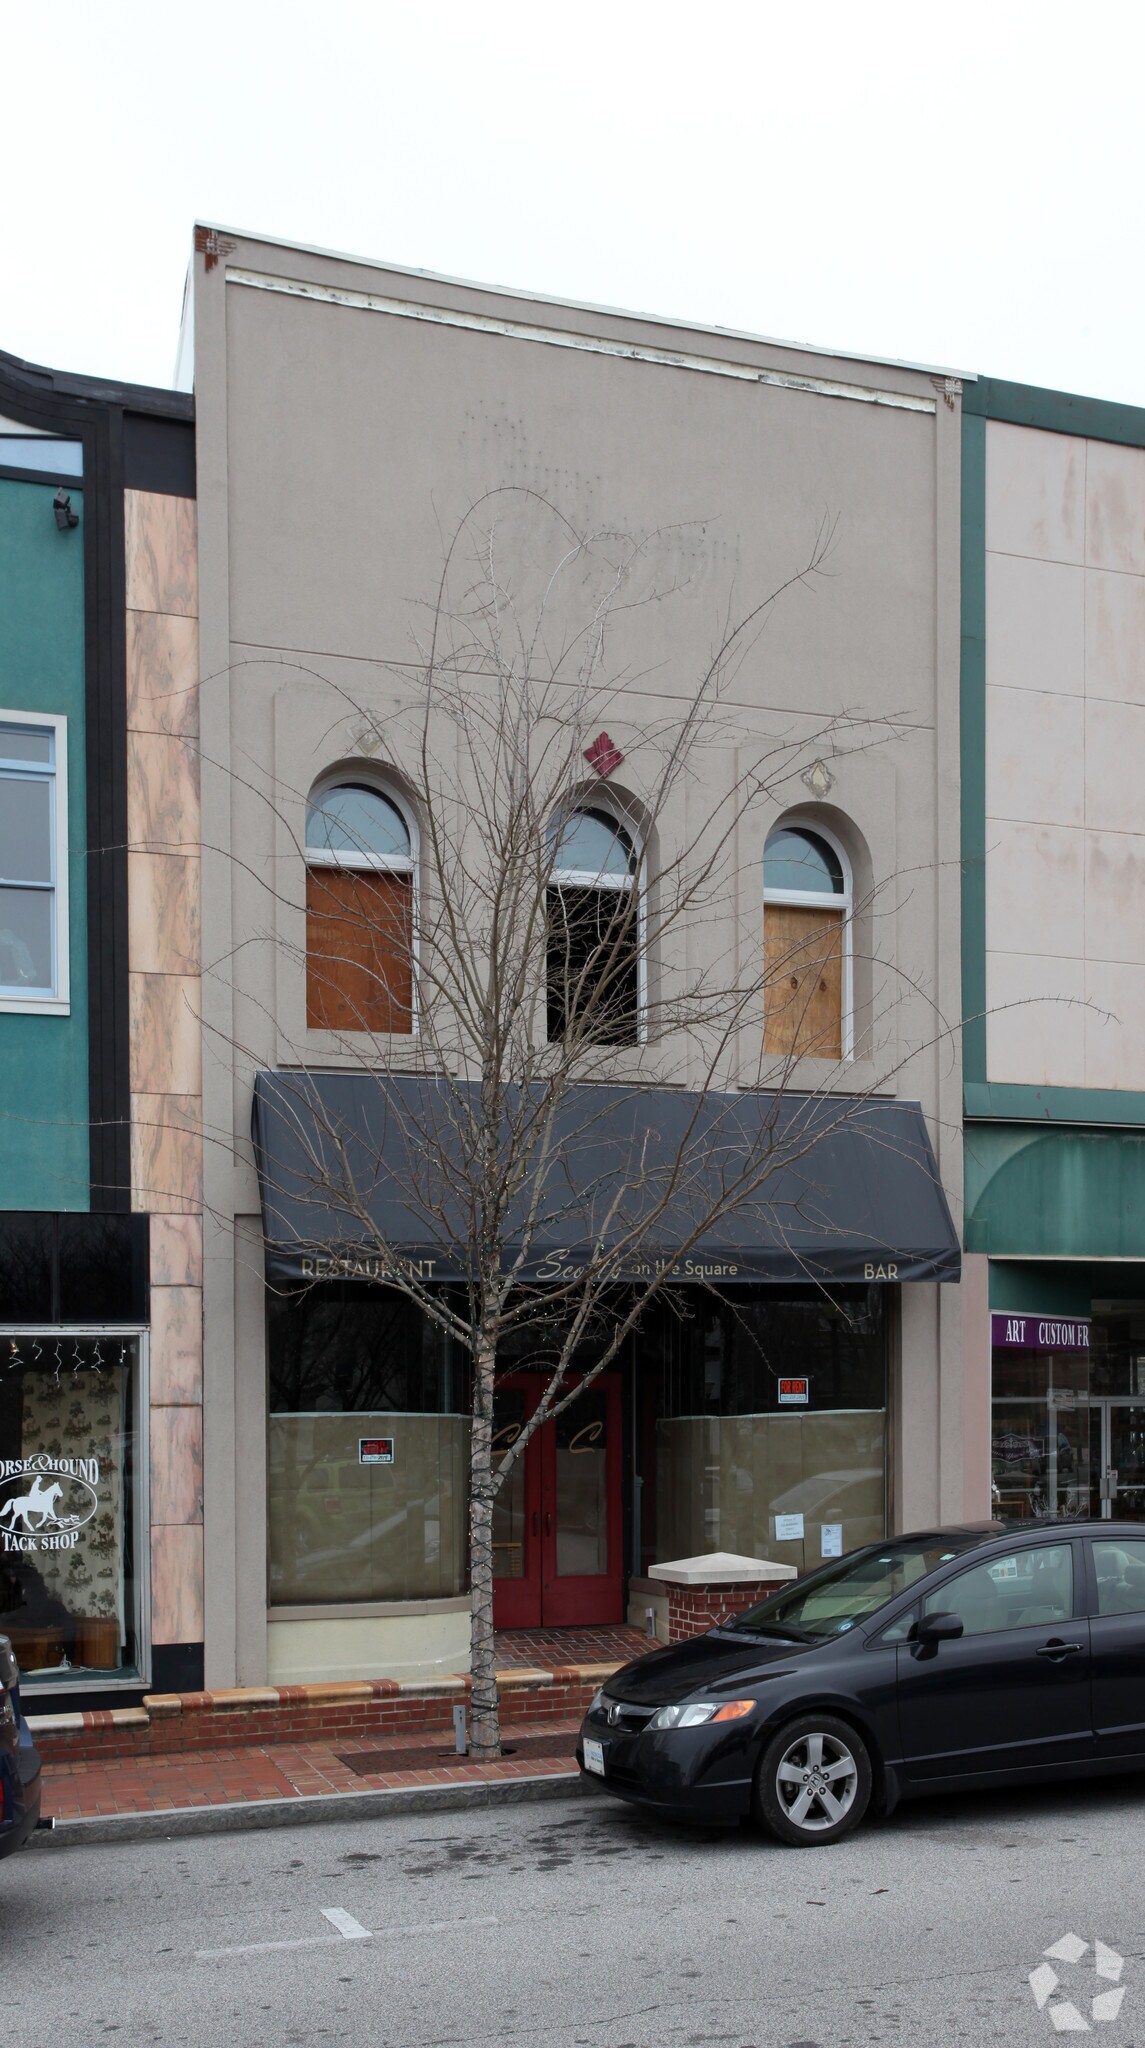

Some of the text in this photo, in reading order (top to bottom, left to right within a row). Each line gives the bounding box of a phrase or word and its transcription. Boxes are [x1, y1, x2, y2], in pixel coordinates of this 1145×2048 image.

[301, 1259, 436, 1278] RESTAURNT
[685, 1260, 738, 1279] Square
[864, 1263, 898, 1279] BAR
[1005, 1319, 1090, 1347] ART CUSTOM FR
[781, 1380, 805, 1393] FOR RENT
[362, 1446, 389, 1455] RENT
[2, 1531, 79, 1551] TACK SHOP
